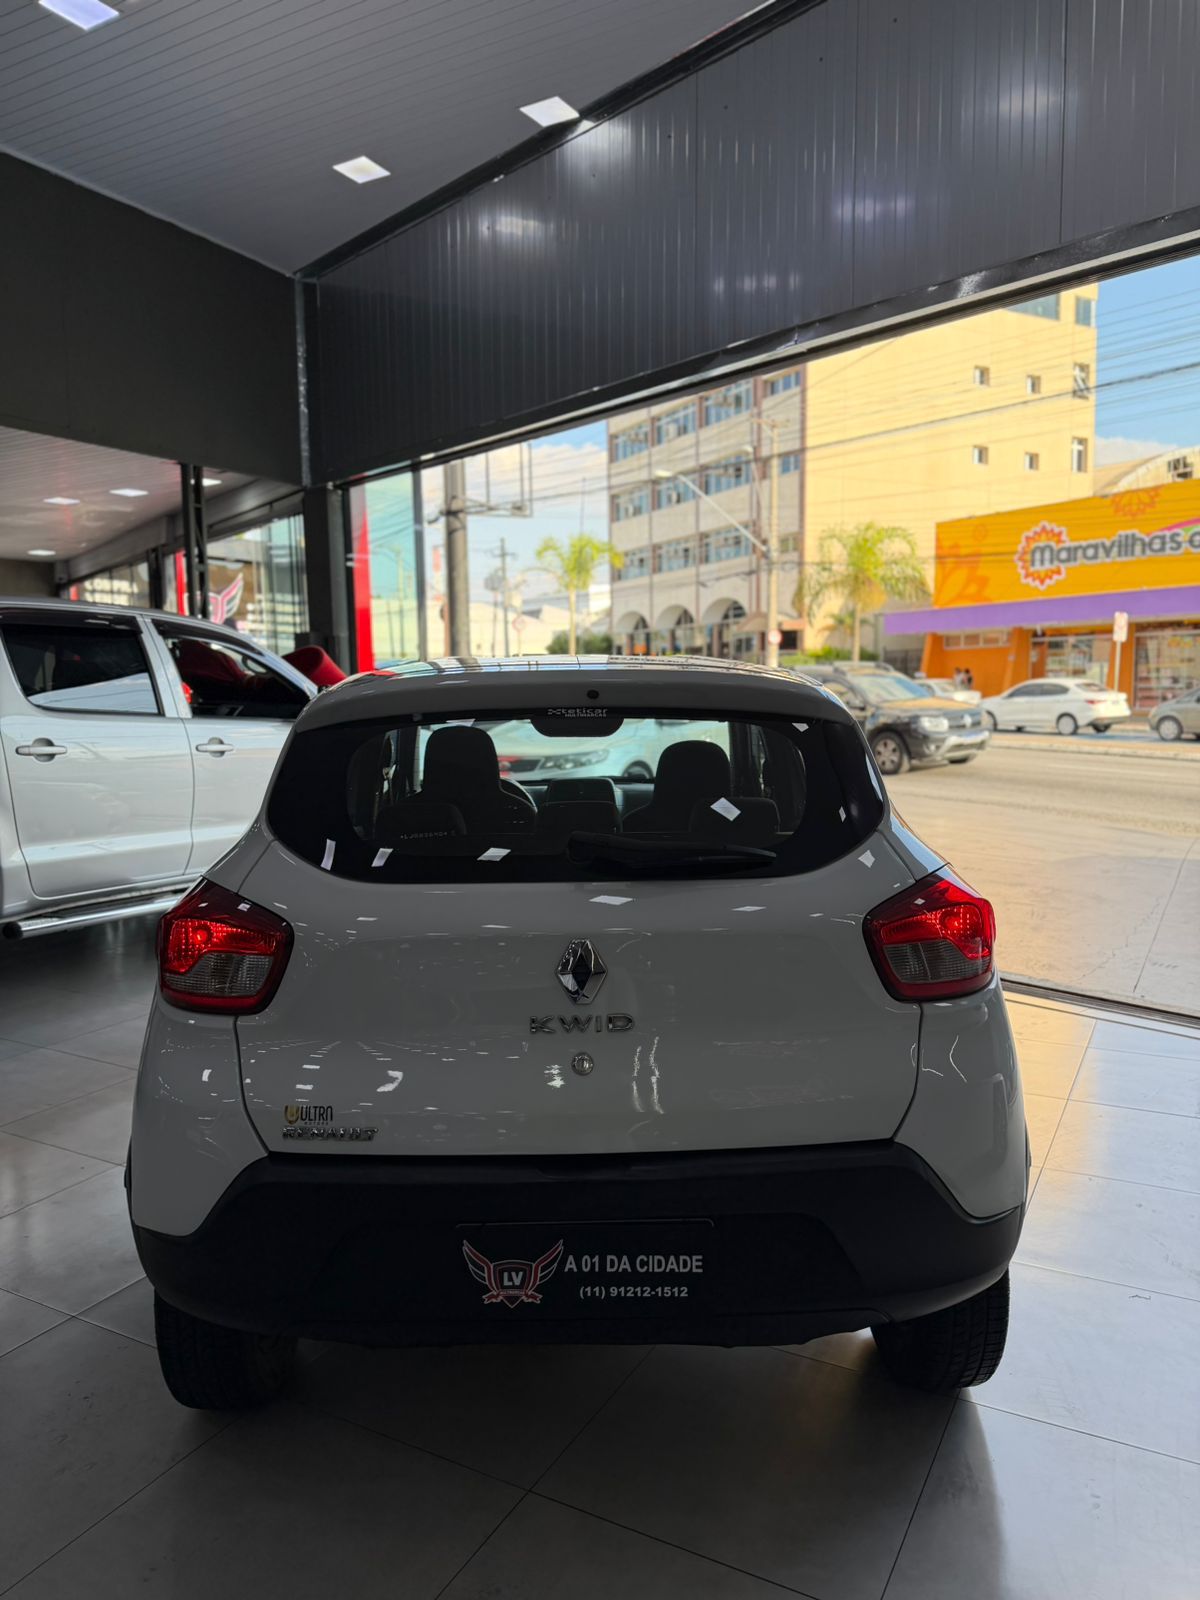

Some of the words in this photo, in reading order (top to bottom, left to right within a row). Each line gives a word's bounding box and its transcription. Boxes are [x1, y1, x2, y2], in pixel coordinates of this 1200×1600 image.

[1030, 531, 1182, 567] Maravilhas
[529, 1014, 635, 1034] KWID
[282, 1127, 378, 1141] RENAULT
[564, 1255, 577, 1272] A
[581, 1255, 600, 1272] 01
[606, 1255, 632, 1272] DA
[636, 1255, 703, 1273] CIDADE
[503, 1271, 524, 1286] LV
[579, 1286, 606, 1300] (11)
[609, 1286, 689, 1297] 91212-1512
